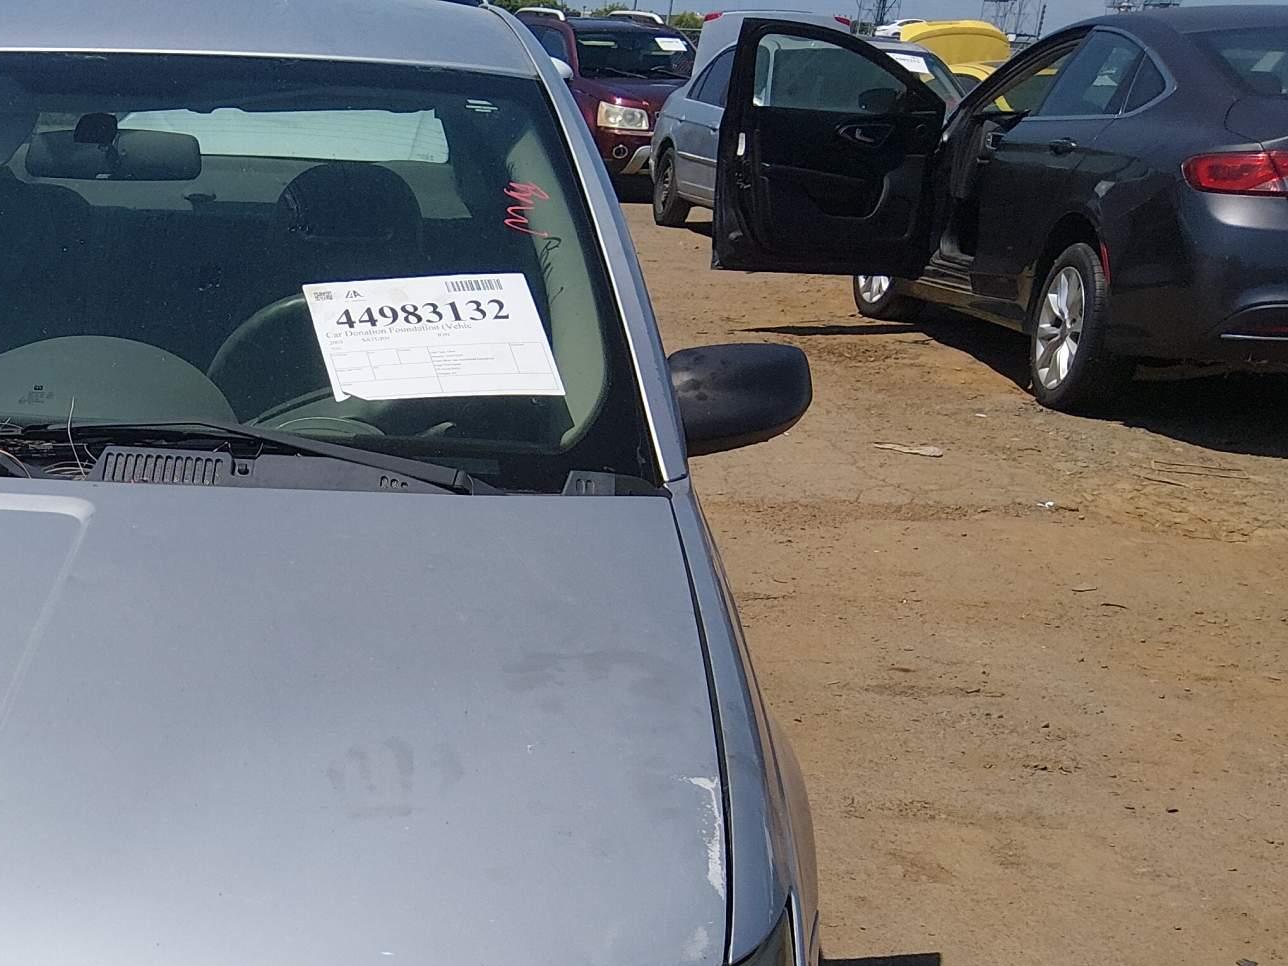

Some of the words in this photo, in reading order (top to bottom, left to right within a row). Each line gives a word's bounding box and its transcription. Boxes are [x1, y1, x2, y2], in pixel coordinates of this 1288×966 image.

[336, 297, 510, 329] 44983132
[344, 329, 387, 337] Donation
[388, 323, 440, 334] Foundation
